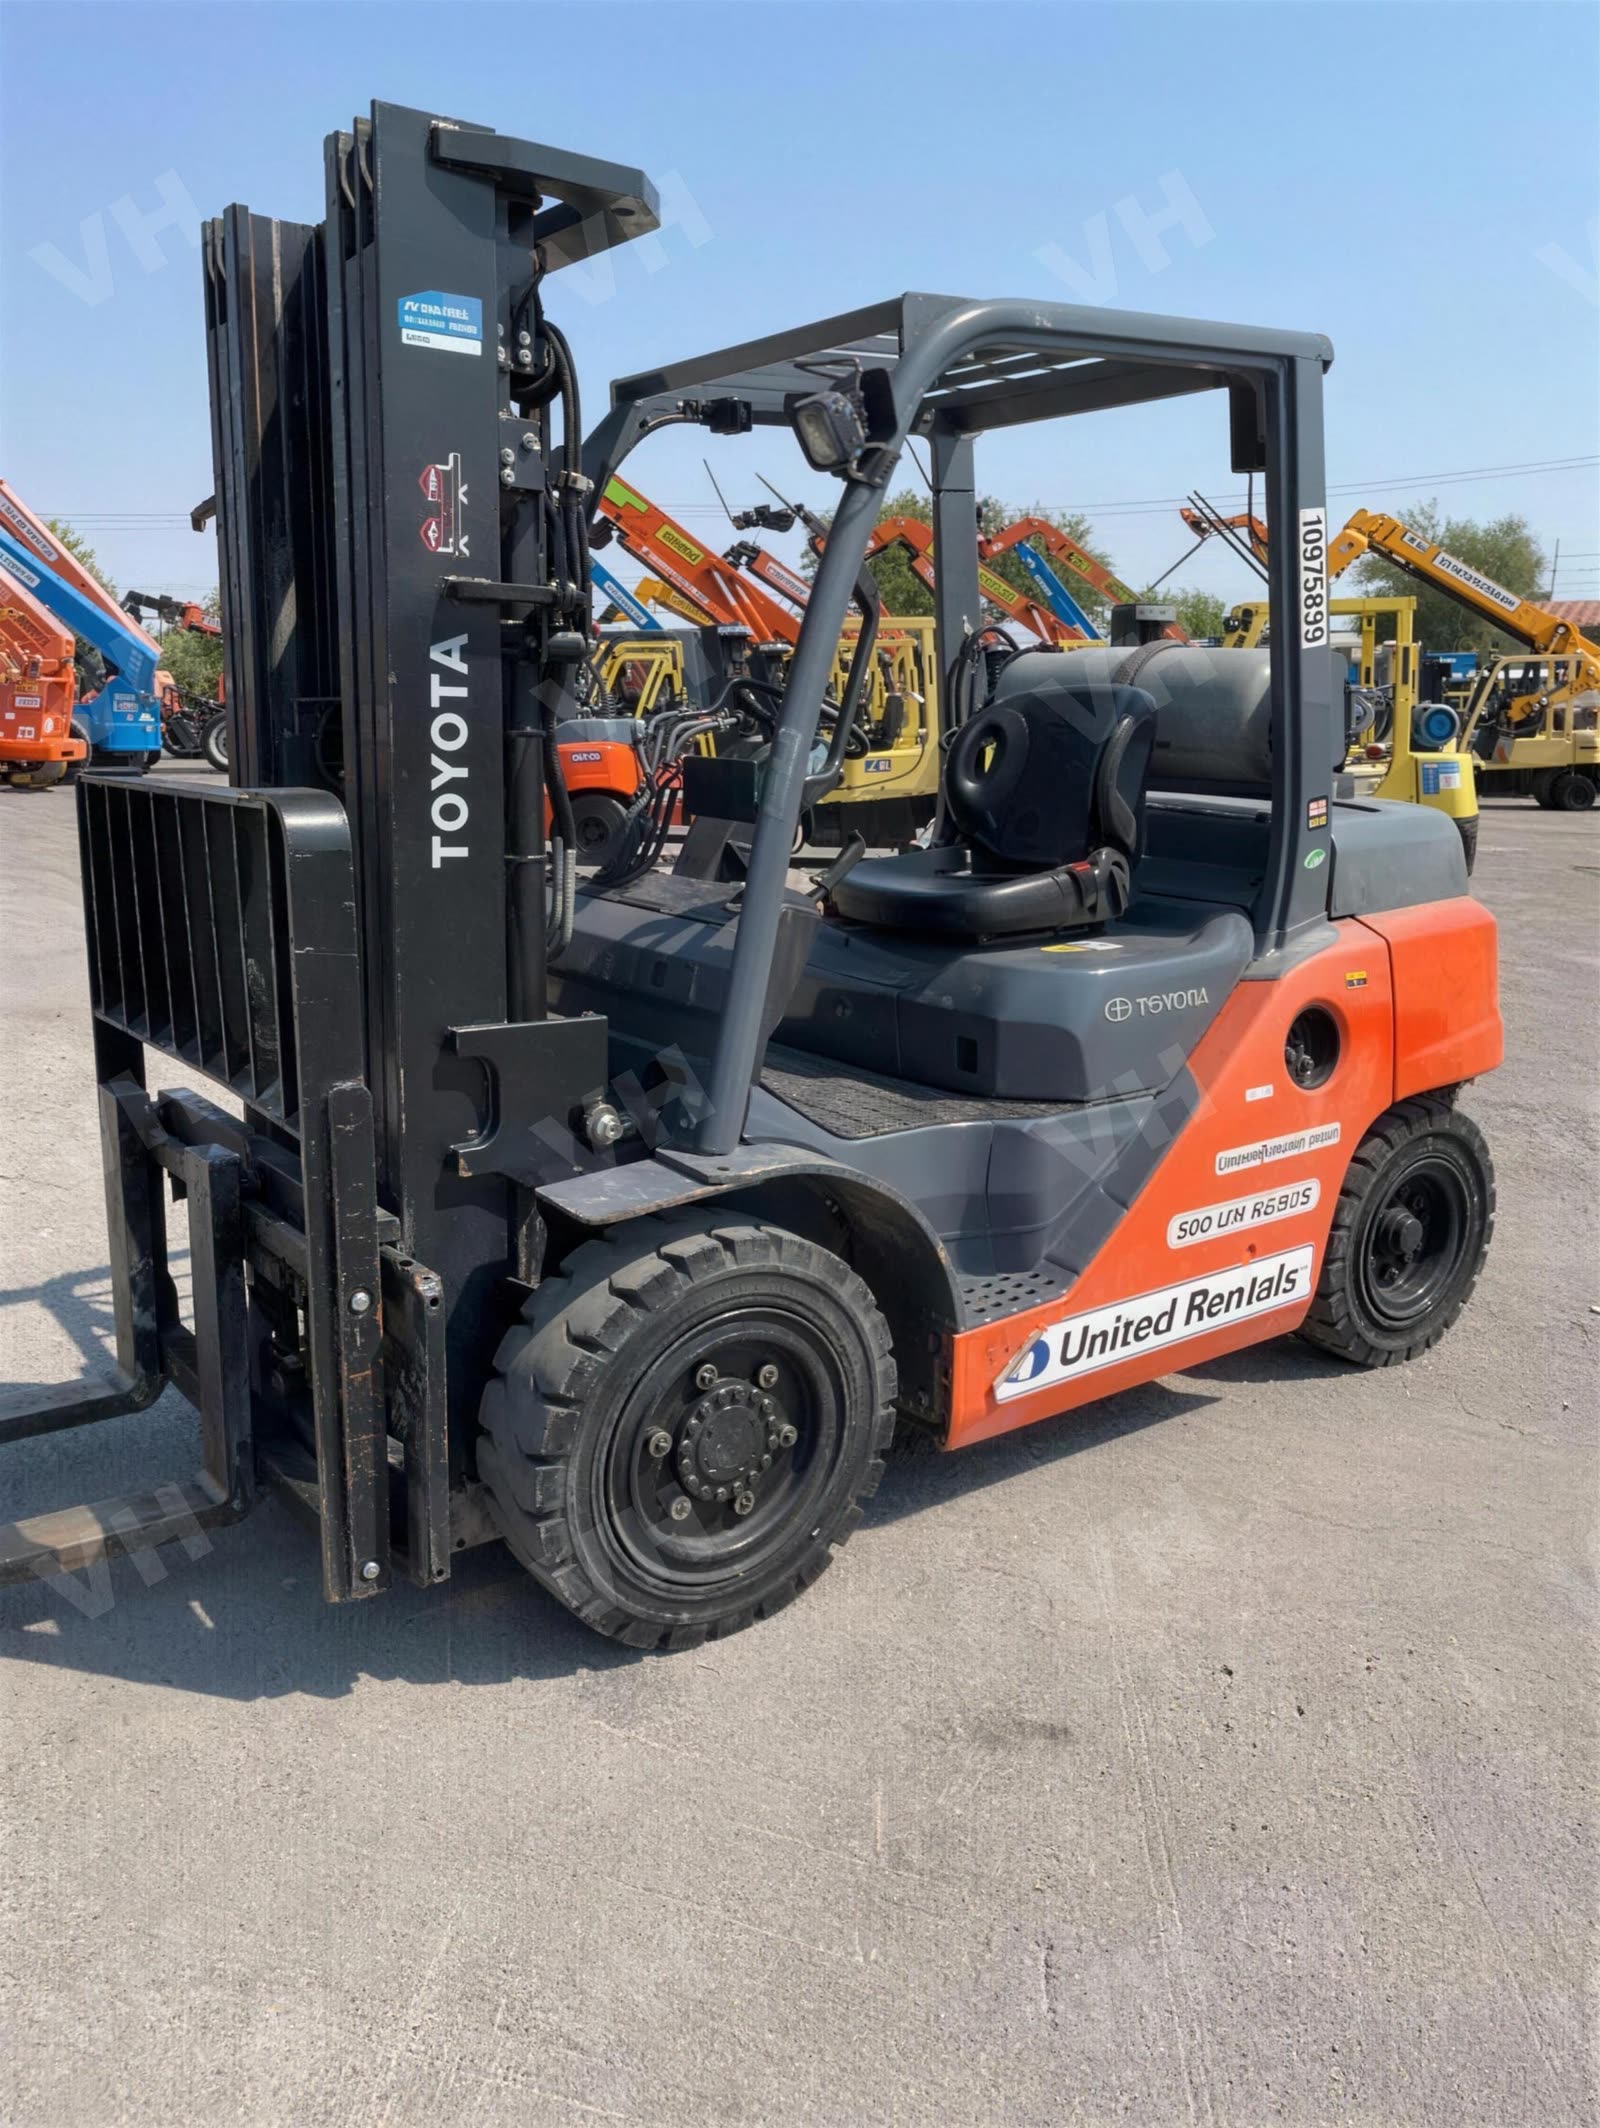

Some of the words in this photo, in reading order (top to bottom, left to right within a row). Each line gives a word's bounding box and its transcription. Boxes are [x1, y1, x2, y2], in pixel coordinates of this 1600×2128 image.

[1302, 515, 1325, 643] 10975899
[429, 633, 469, 868] TOYOTA
[1060, 1297, 1178, 1366] United
